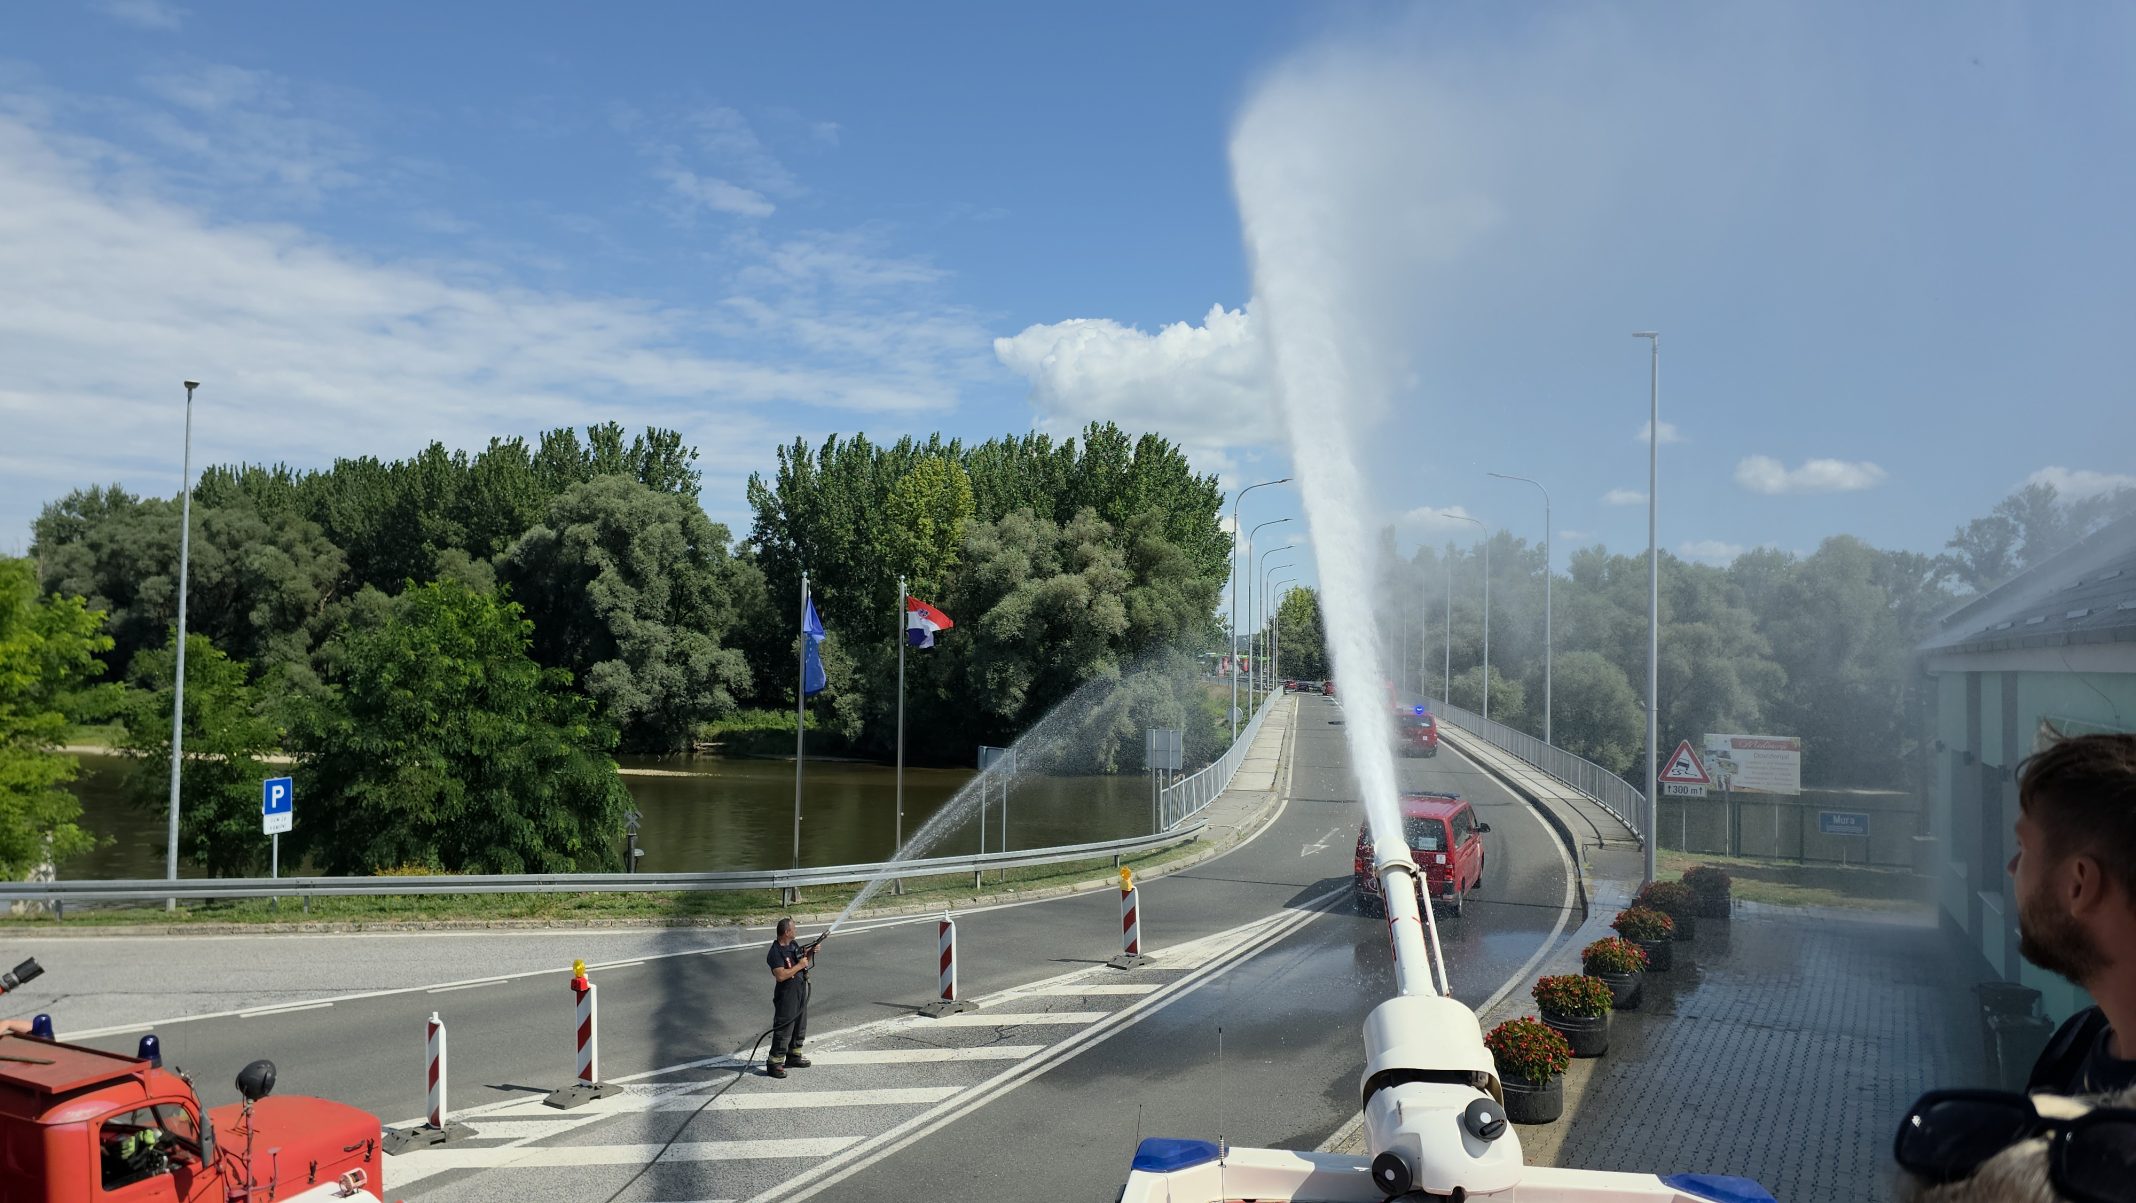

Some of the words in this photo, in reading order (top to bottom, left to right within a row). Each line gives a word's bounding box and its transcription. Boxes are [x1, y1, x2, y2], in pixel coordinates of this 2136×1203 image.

[1672, 785, 1689, 795] 300
[271, 784, 285, 808] P
[1832, 814, 1856, 825] Mura
